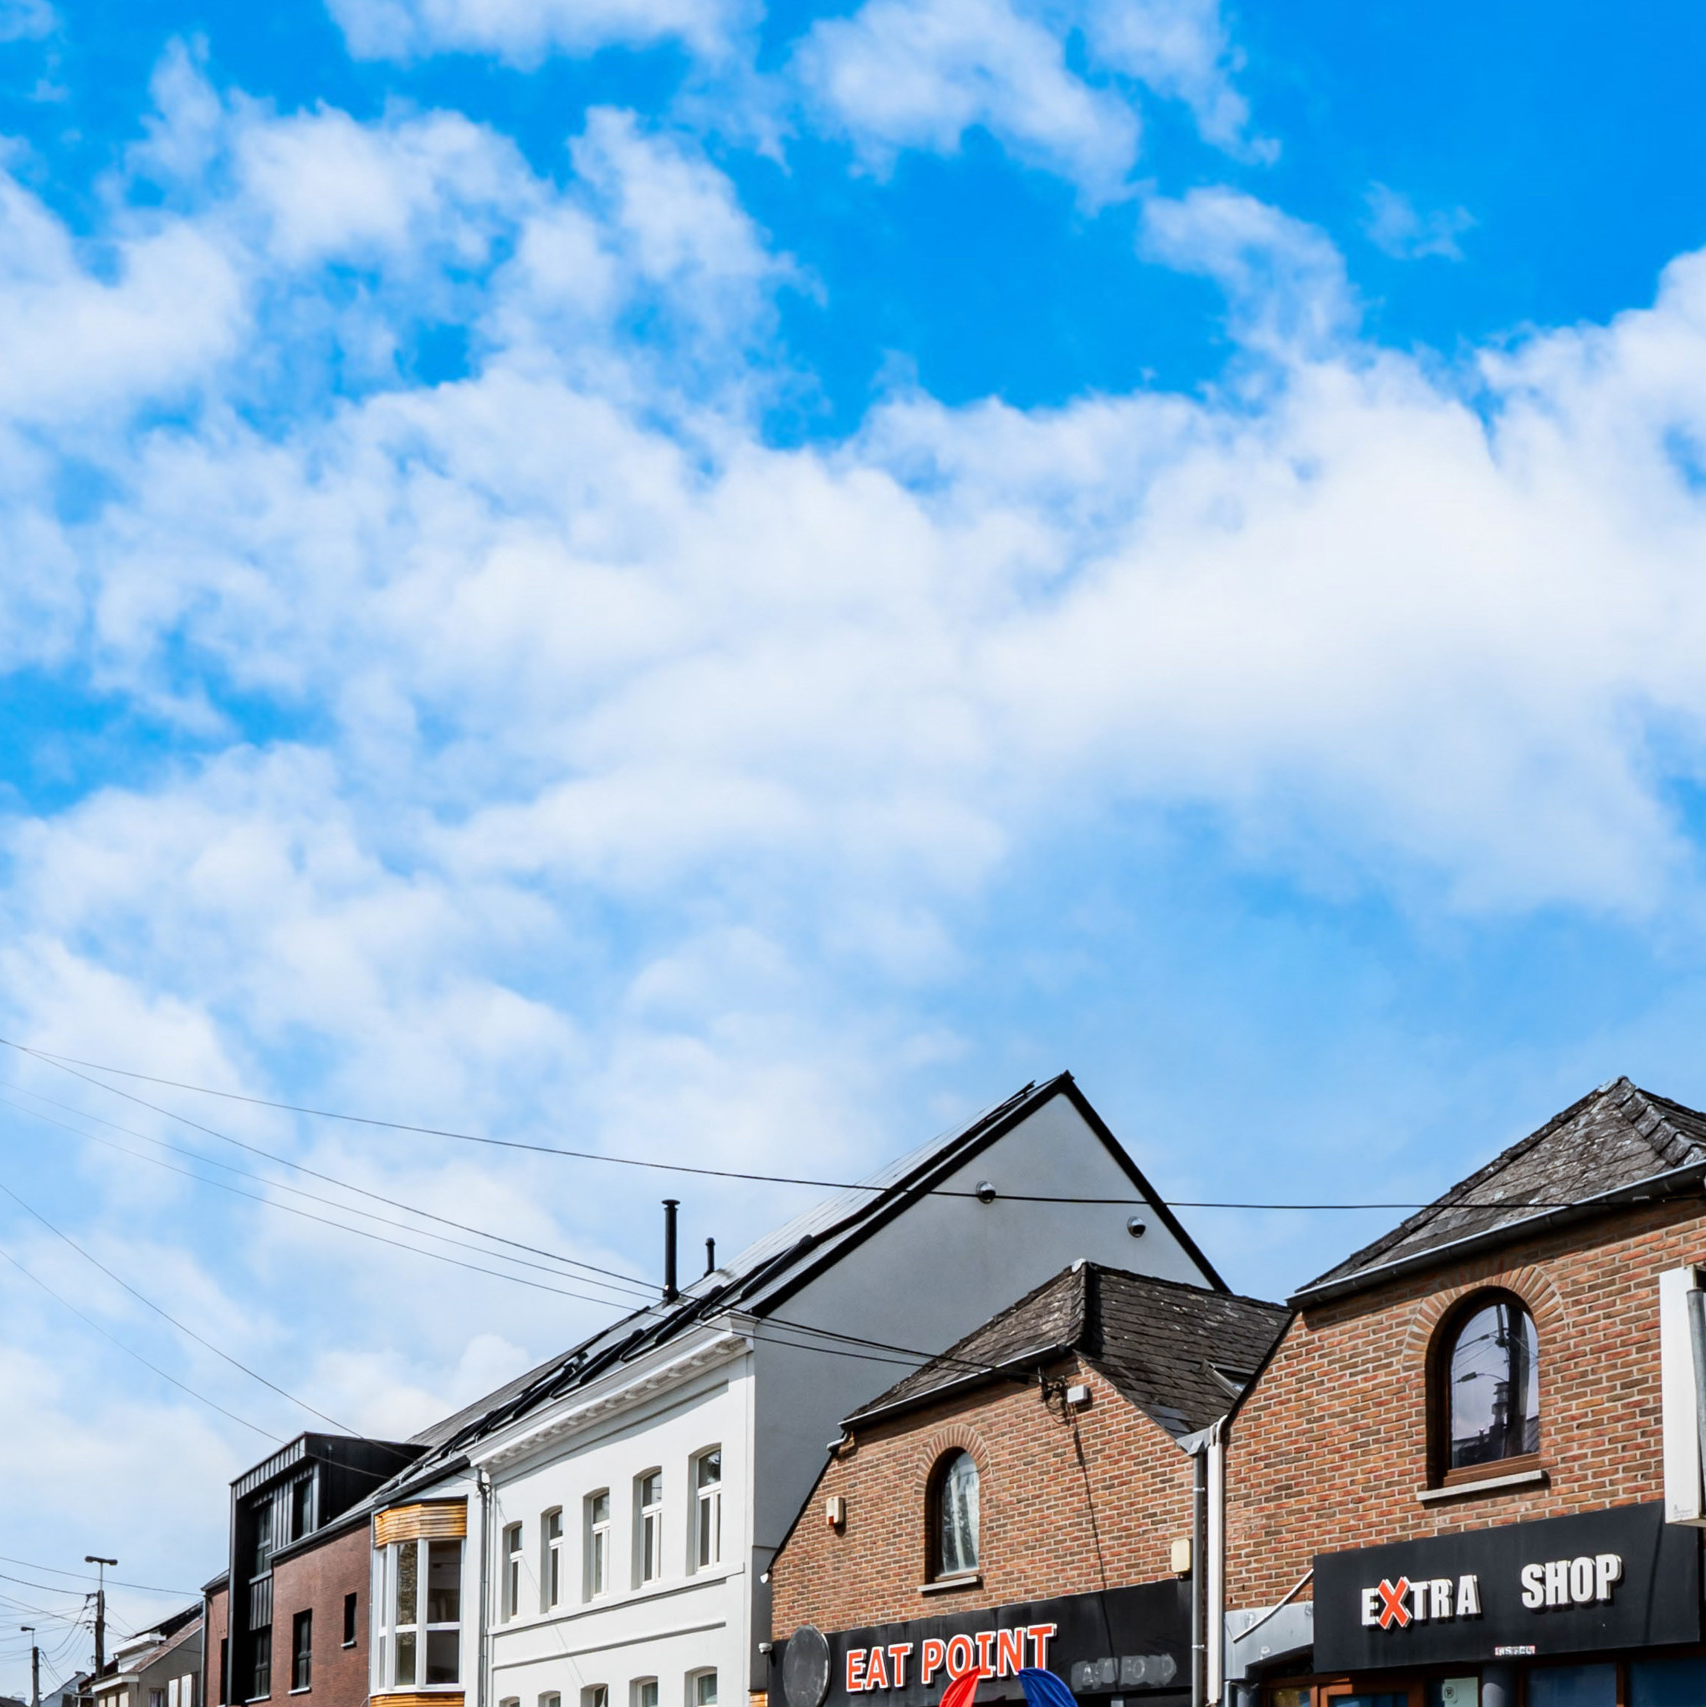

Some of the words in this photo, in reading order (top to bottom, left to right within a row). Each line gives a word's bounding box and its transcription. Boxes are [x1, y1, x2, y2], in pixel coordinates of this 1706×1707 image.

[1361, 1575, 1481, 1629] EXTRA
[1521, 1554, 1622, 1609] SHOP
[846, 1643, 913, 1692] EAT
[921, 1624, 1057, 1684] POINT
